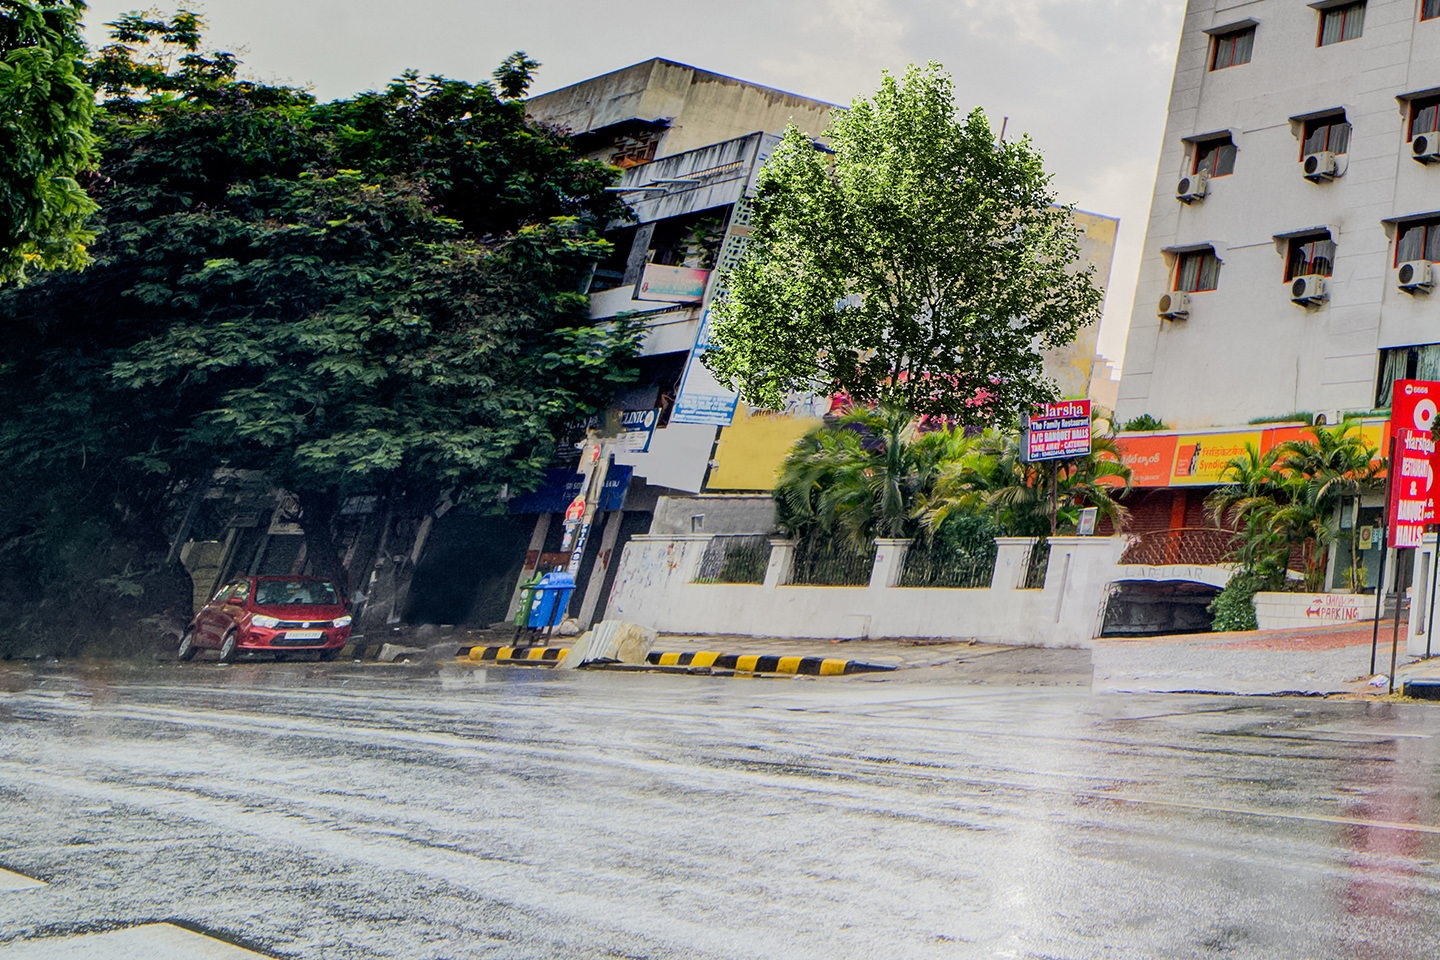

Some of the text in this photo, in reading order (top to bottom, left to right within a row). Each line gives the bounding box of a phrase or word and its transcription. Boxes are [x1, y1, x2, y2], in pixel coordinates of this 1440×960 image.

[1032, 422, 1042, 431] The
[1031, 433, 1043, 444] A/C
[1410, 481, 1417, 496] &
[1321, 607, 1359, 620] PARKING
